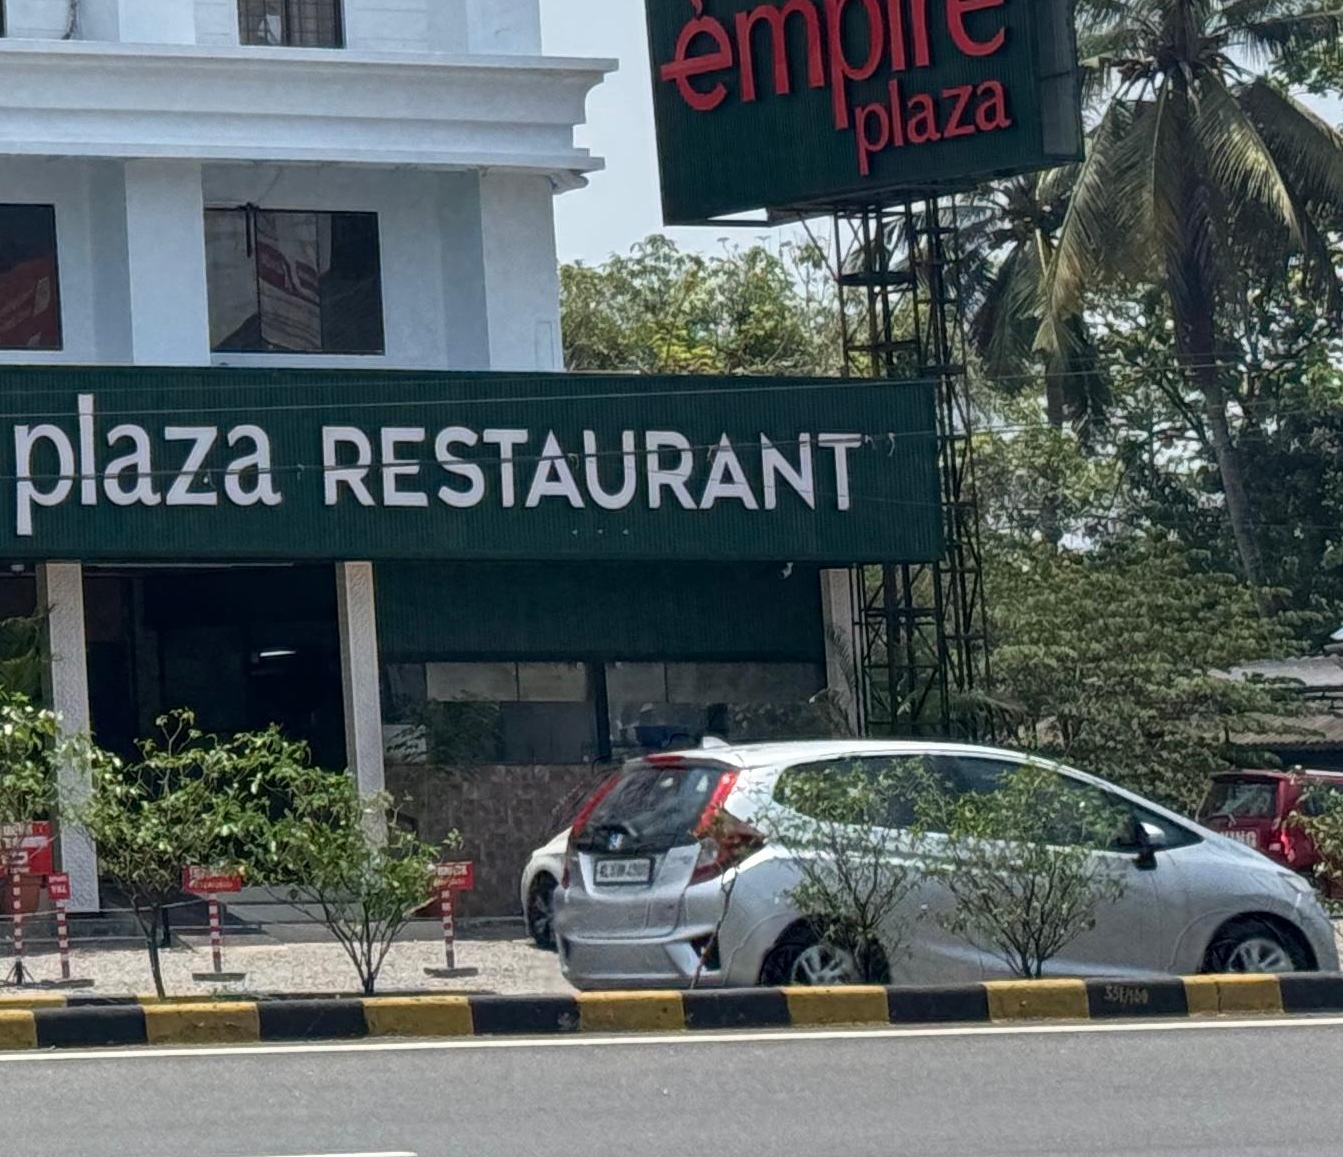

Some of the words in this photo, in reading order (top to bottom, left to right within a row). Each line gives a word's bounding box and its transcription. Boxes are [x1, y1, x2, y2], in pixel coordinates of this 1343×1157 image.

[854, 78, 1012, 176] plaza
[14, 393, 282, 536] plaza
[321, 426, 863, 511] RESTAURANT
